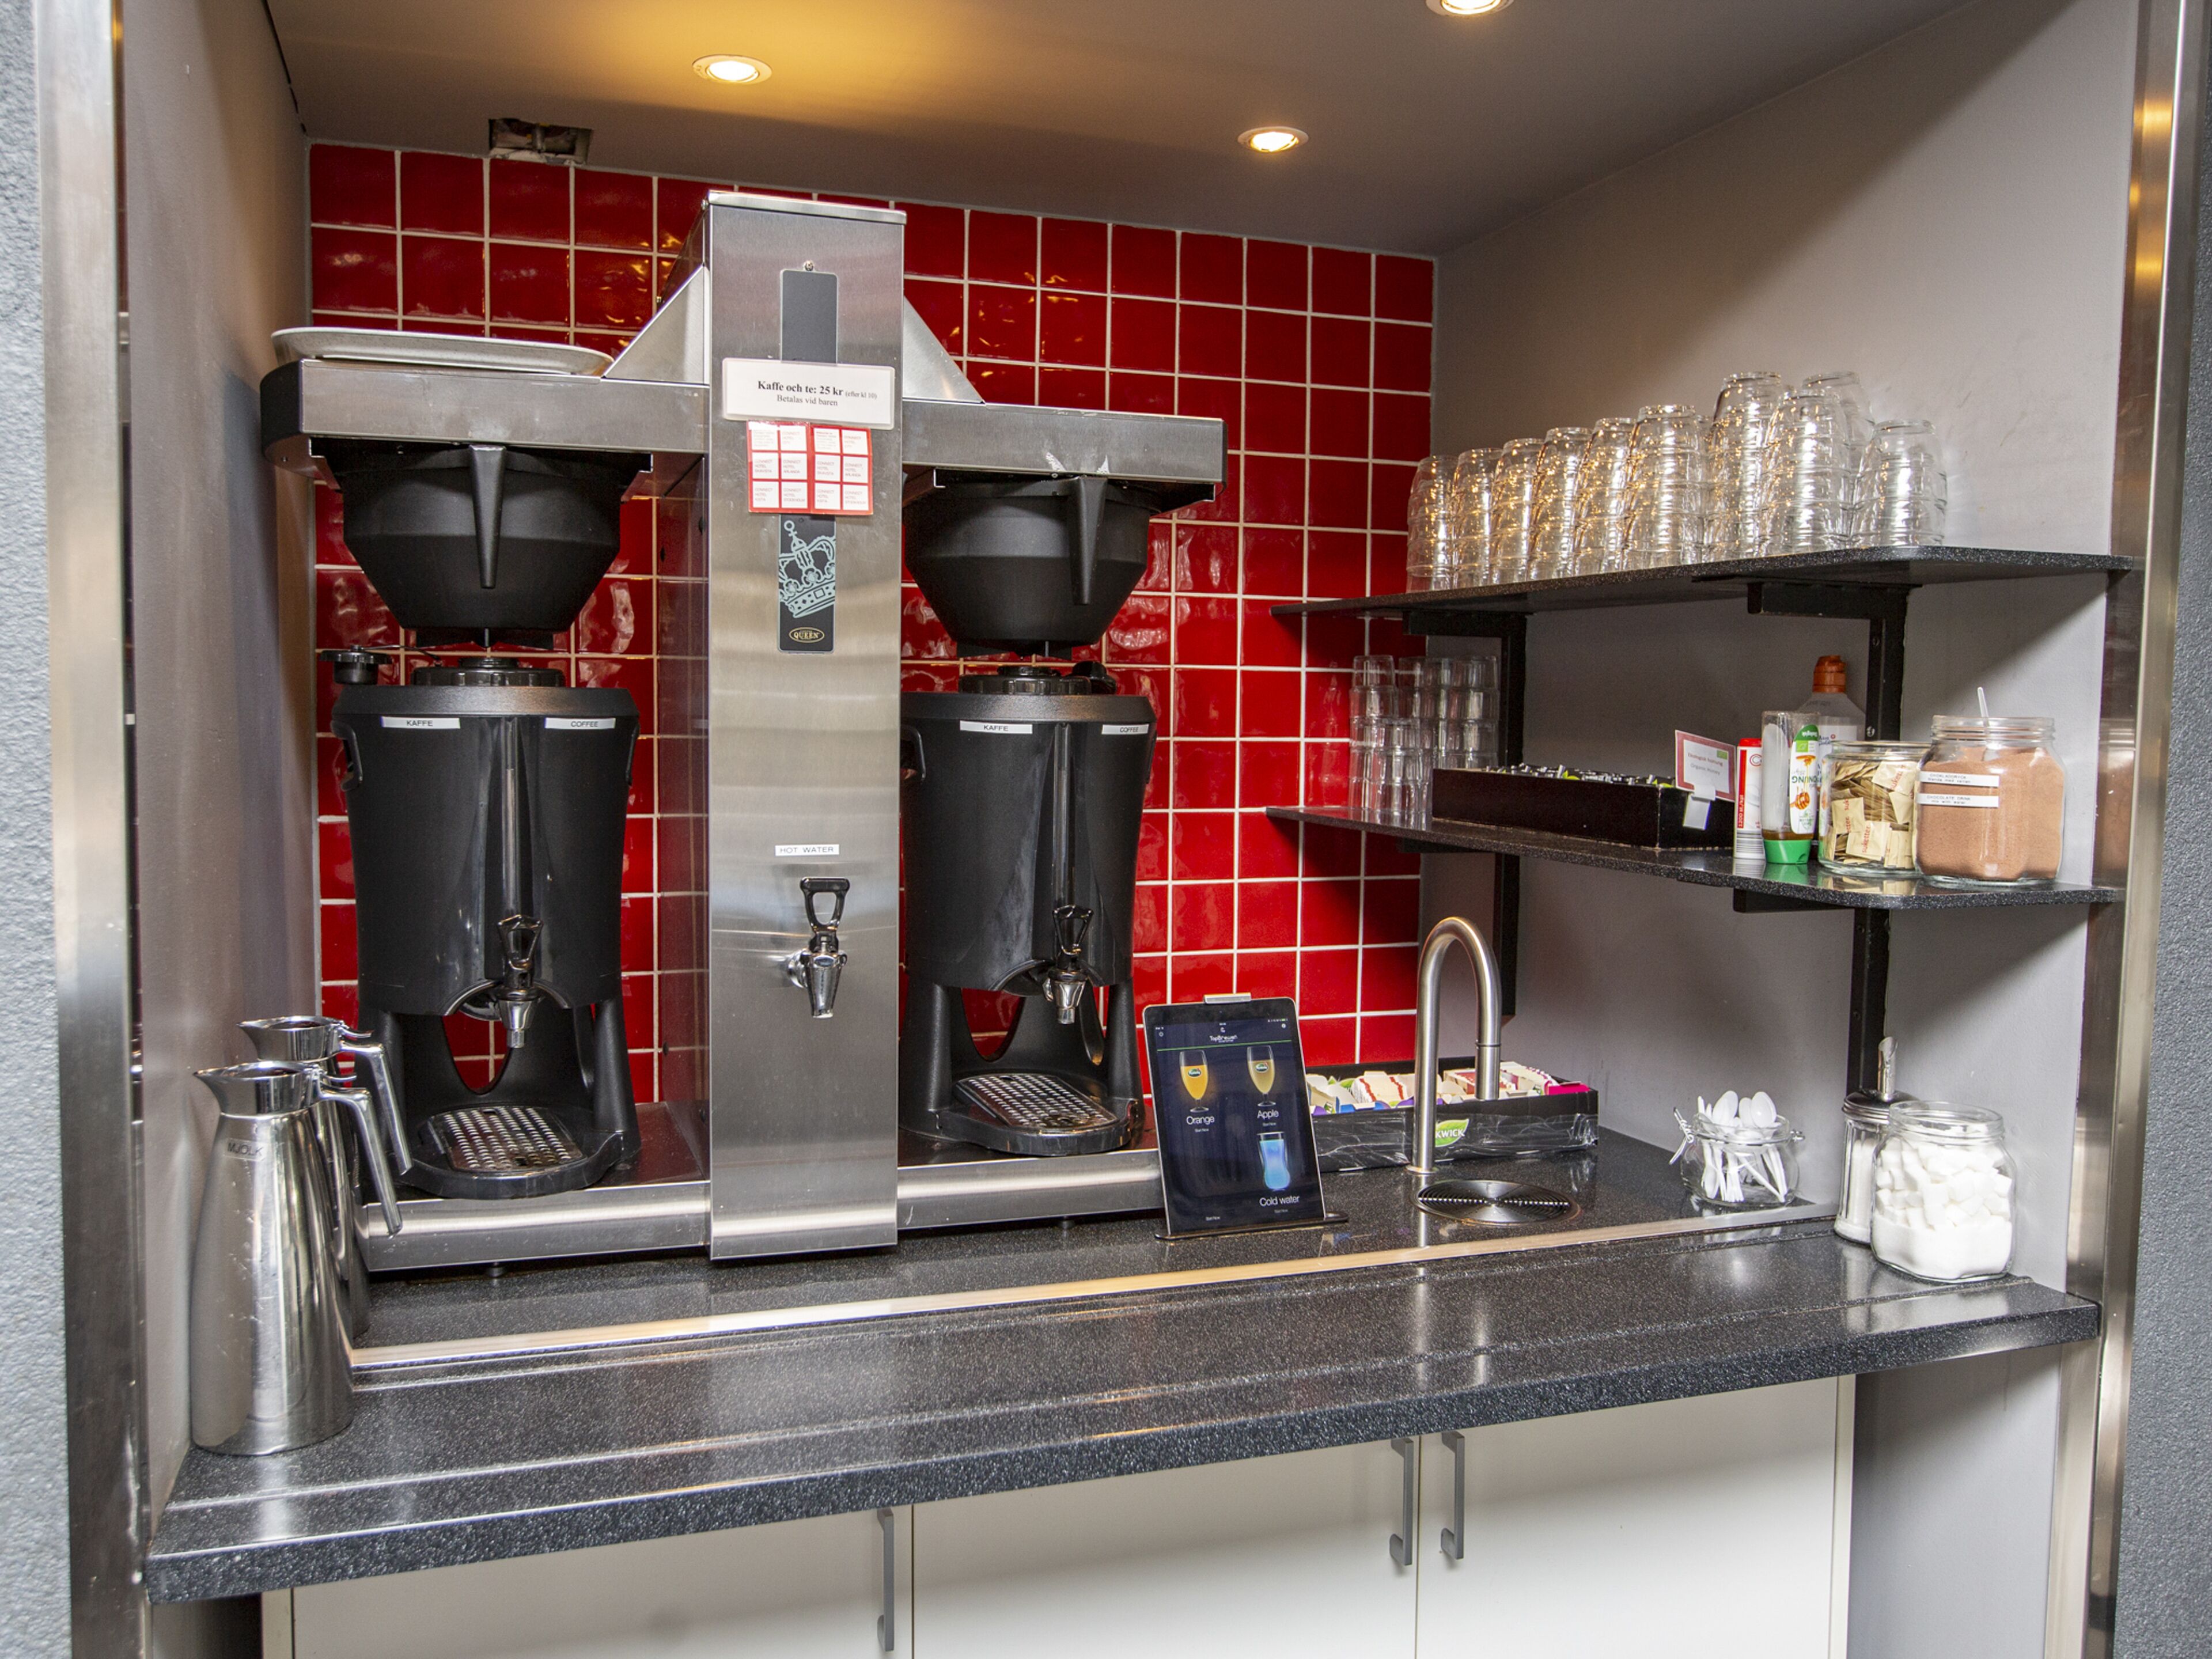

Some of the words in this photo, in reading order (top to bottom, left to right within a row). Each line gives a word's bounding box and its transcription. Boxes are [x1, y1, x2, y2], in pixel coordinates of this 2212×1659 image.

[757, 380, 784, 391] Kaffe
[786, 384, 802, 393] och
[805, 385, 817, 394] te:
[820, 385, 831, 395] 25
[833, 387, 844, 396] kr
[777, 395, 804, 404] Betalas
[805, 396, 817, 404] vid
[818, 398, 838, 407] baren
[793, 630, 820, 640] QUEEN
[1862, 825, 1870, 853] suketter
[1257, 1109, 1279, 1119] Apple
[1186, 1116, 1215, 1125] Orange
[1435, 1128, 1465, 1139] KWICK
[1259, 1196, 1278, 1206] Cold
[1279, 1195, 1300, 1205] water
